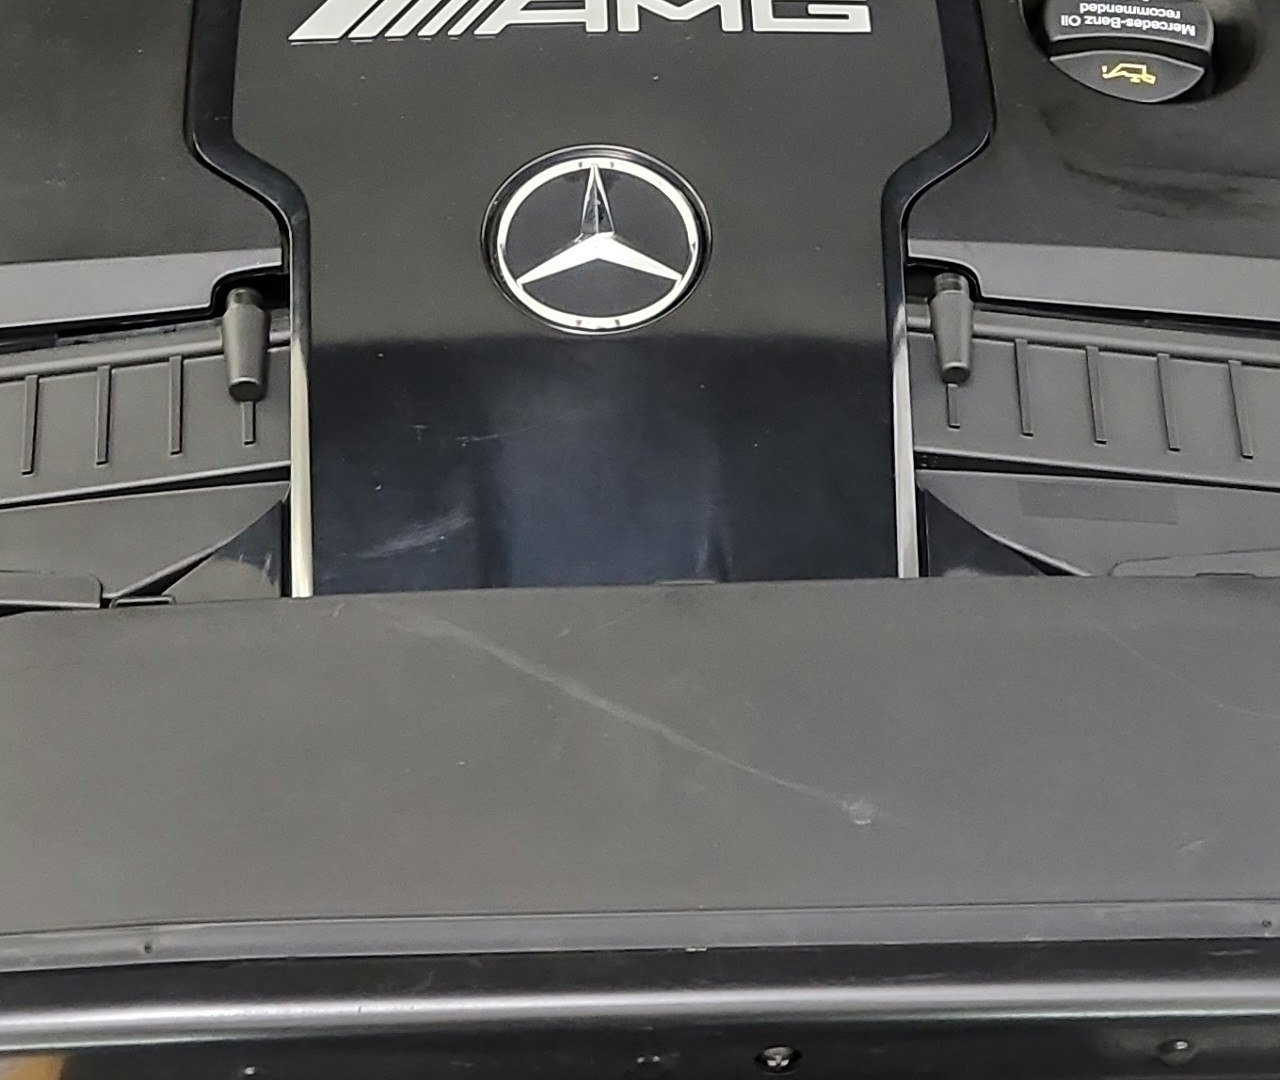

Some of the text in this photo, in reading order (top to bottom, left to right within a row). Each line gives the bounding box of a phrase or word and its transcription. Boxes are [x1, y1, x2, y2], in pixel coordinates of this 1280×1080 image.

[1079, 2, 1181, 19] recommended
[1060, 15, 1196, 37] Mercedes-Benz Oil
